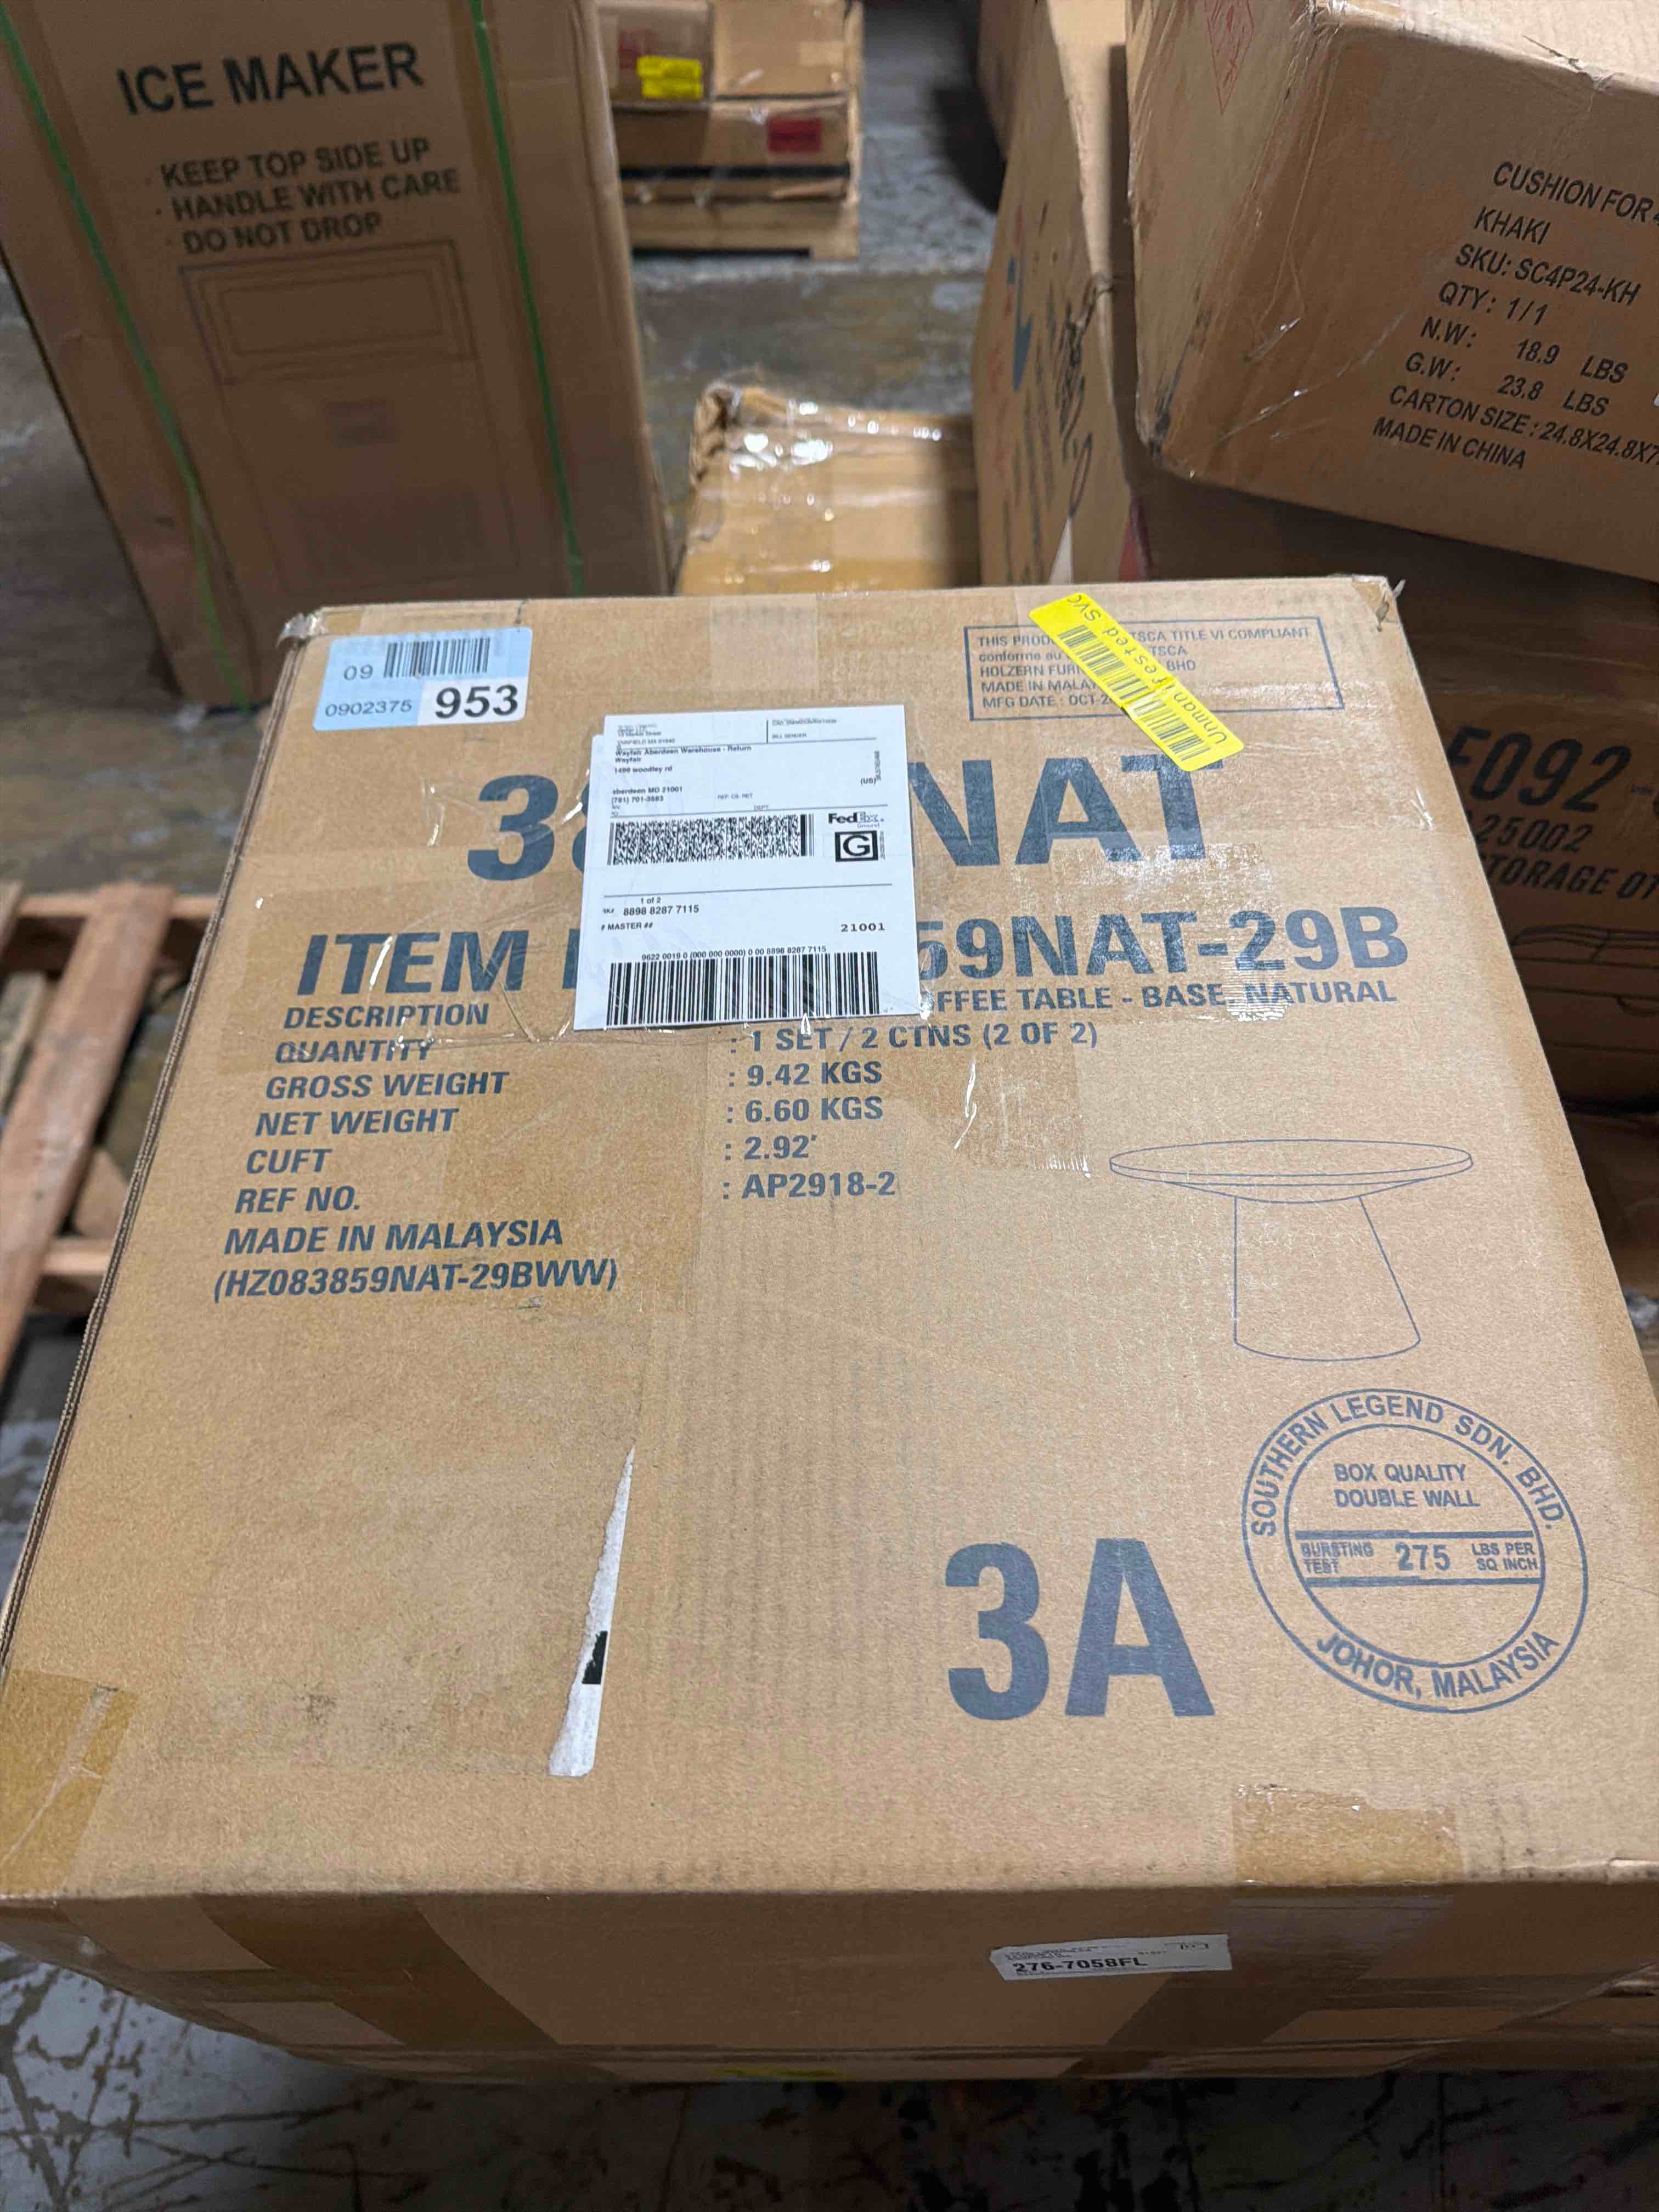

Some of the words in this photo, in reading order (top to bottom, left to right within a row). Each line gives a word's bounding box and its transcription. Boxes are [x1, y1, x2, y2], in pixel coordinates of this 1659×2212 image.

[117, 61, 213, 115] ICE
[223, 42, 424, 105] MAKER
[160, 156, 240, 189] KEEP
[247, 150, 307, 180] TOP
[317, 142, 382, 173] SIDE
[392, 137, 430, 165] UP
[171, 187, 294, 221] HANDLE
[298, 177, 374, 210] WITH
[382, 168, 459, 201] CARE
[1493, 161, 1601, 208] CUSHION
[1601, 189, 1654, 223] FOR
[183, 227, 227, 255] DO
[235, 221, 292, 249] NOT
[303, 212, 382, 244] DROP
[1474, 206, 1550, 244] KHAKI
[1455, 243, 1511, 276] SKU:
[1515, 257, 1642, 305] SC4P24-KH
[1517, 338, 1560, 365] 18.9
[1581, 356, 1629, 383] LBS
[1389, 385, 1480, 423] CARTON
[1497, 374, 1544, 400] 23.8
[1562, 389, 1610, 416] LBS
[1373, 416, 1437, 449] MADE
[1436, 431, 1462, 453] IN
[1463, 438, 1526, 470] CHINA
[979, 636, 1008, 647] THIS
[1172, 629, 1207, 641] TITLE
[1211, 629, 1224, 640] VI
[1228, 628, 1309, 639] COMPLIANT
[979, 651, 1041, 662] conforme
[1149, 646, 1187, 657] TSCA
[343, 664, 374, 681] 09
[980, 664, 1042, 677] HOLZERN
[981, 681, 1024, 693] MADE
[1029, 680, 1042, 691] IN
[1105, 627, 1227, 744] Unmanifested
[325, 699, 413, 717] 0902375
[435, 684, 518, 719] 953
[983, 696, 1015, 708] MFG
[645, 747, 679, 755] Aberdeen
[843, 834, 871, 856] G
[1465, 809, 1594, 853] 25002
[1480, 852, 1618, 895] TORAGE
[623, 907, 647, 916] 8898
[650, 906, 673, 915] 8287
[676, 905, 699, 913] 7115
[840, 922, 885, 932] 21001
[297, 930, 529, 995] ITEM
[690, 951, 706, 960] (000
[724, 949, 746, 958] 0000)
[284, 1003, 489, 1029] DESCRIPTION
[1016, 986, 1112, 1012] TABLE
[1142, 983, 1225, 1008] BASE
[1245, 980, 1397, 1006] NATURAL
[275, 1037, 436, 1064] QUANTITY
[775, 1028, 832, 1051] SET
[861, 1026, 878, 1049] 2
[888, 1024, 971, 1048] CTNS
[983, 1023, 1010, 1050] (2
[1021, 1023, 1058, 1045] OF
[1071, 1022, 1098, 1047] 2)
[266, 1074, 373, 1099] GROSS
[382, 1071, 510, 1098] WEIGHT
[747, 1064, 811, 1087] 9.42
[821, 1060, 882, 1085] KGS
[255, 1111, 321, 1137] NET
[330, 1108, 459, 1135] WEIGHT
[745, 1099, 810, 1123] 6.60
[821, 1097, 883, 1120] KGS
[246, 1148, 332, 1174] CUFT
[234, 1188, 297, 1214] REF
[306, 1185, 360, 1211] NO.
[741, 1171, 896, 1199] AP2918-2
[224, 1225, 330, 1255] MADE
[337, 1224, 376, 1252] IN
[385, 1219, 563, 1251] MALAYSIA
[214, 1258, 618, 1303] (HZ083859NAT-29BWW)
[1250, 1411, 1329, 1537] SOUTHERN
[1330, 1395, 1444, 1424] LEGEND
[1455, 1414, 1514, 1467] SDN.
[1516, 1465, 1564, 1531] BHD.
[1334, 1463, 1378, 1482] BOX
[1384, 1463, 1466, 1483] QUALITY
[1334, 1489, 1419, 1508] DOUBLE
[1423, 1490, 1481, 1508] WALL
[1301, 1542, 1374, 1559] BURSTING
[1394, 1542, 1450, 1571] 275
[1471, 1543, 1500, 1556] LBS
[1505, 1542, 1536, 1555] PER
[1304, 1560, 1339, 1575] TEST
[1476, 1558, 1498, 1572] SQ
[1503, 1557, 1538, 1571] INCH
[945, 1538, 1215, 1720] 3A
[1317, 1633, 1422, 1700] JOHOR,
[1431, 1630, 1560, 1699] MALAYSIA
[1012, 1957, 1148, 1972] 276-7058FL
